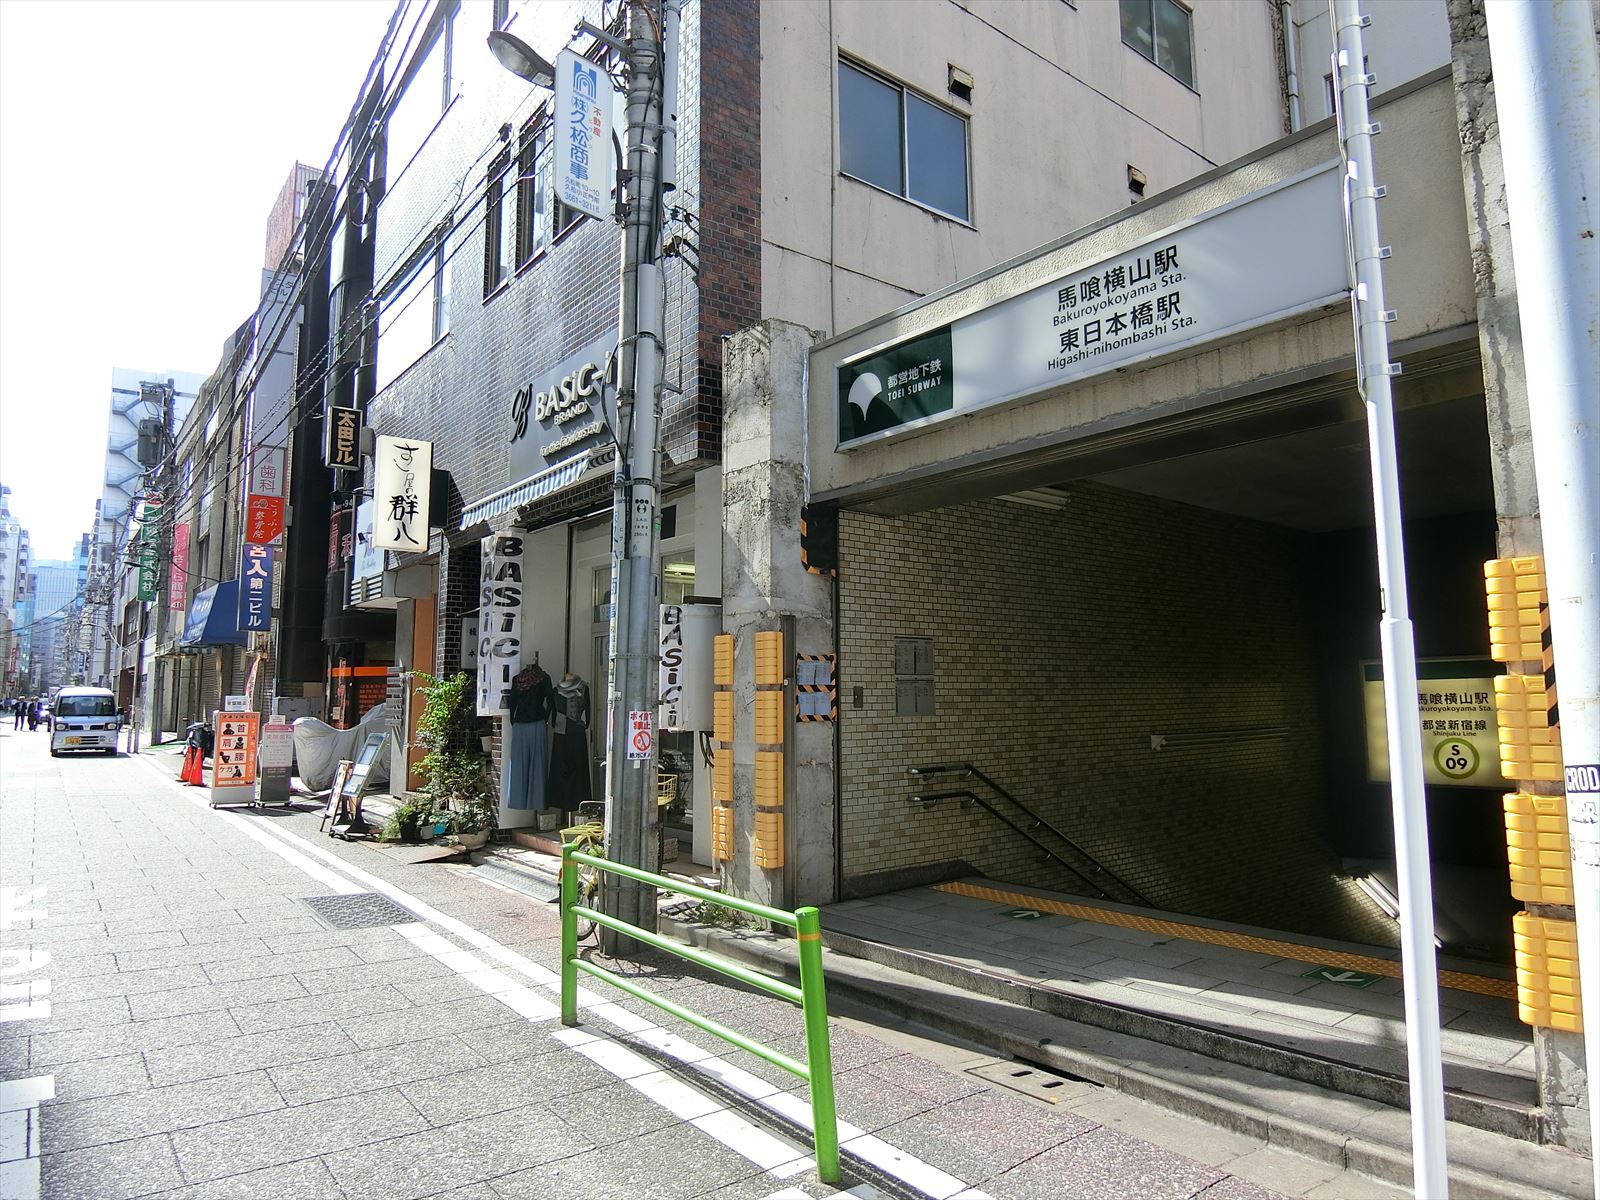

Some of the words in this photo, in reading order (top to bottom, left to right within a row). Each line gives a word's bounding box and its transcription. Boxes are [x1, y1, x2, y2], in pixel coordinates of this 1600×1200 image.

[1058, 245, 1179, 312] 馬喰横山駅
[1053, 282, 1157, 327] Bakuroyokoyama
[1162, 272, 1186, 288] Sta.
[1060, 291, 1181, 354] 東日本橋駅
[1048, 322, 1167, 371] Higashi-nihombashi
[1172, 316, 1197, 331] Sta.
[888, 358, 942, 389] 都営地下鉄
[888, 389, 904, 402] TOEI
[908, 376, 942, 395] SUBWAY
[554, 401, 588, 426] BRAND
[336, 411, 356, 464] 太田ビル
[259, 465, 277, 493] 歯科
[387, 443, 420, 545] すし屋の群八
[252, 511, 265, 539] 整骨院
[1422, 720, 1487, 731] 都営新宿線
[1446, 757, 1468, 770] 09
[1451, 745, 1460, 756] S
